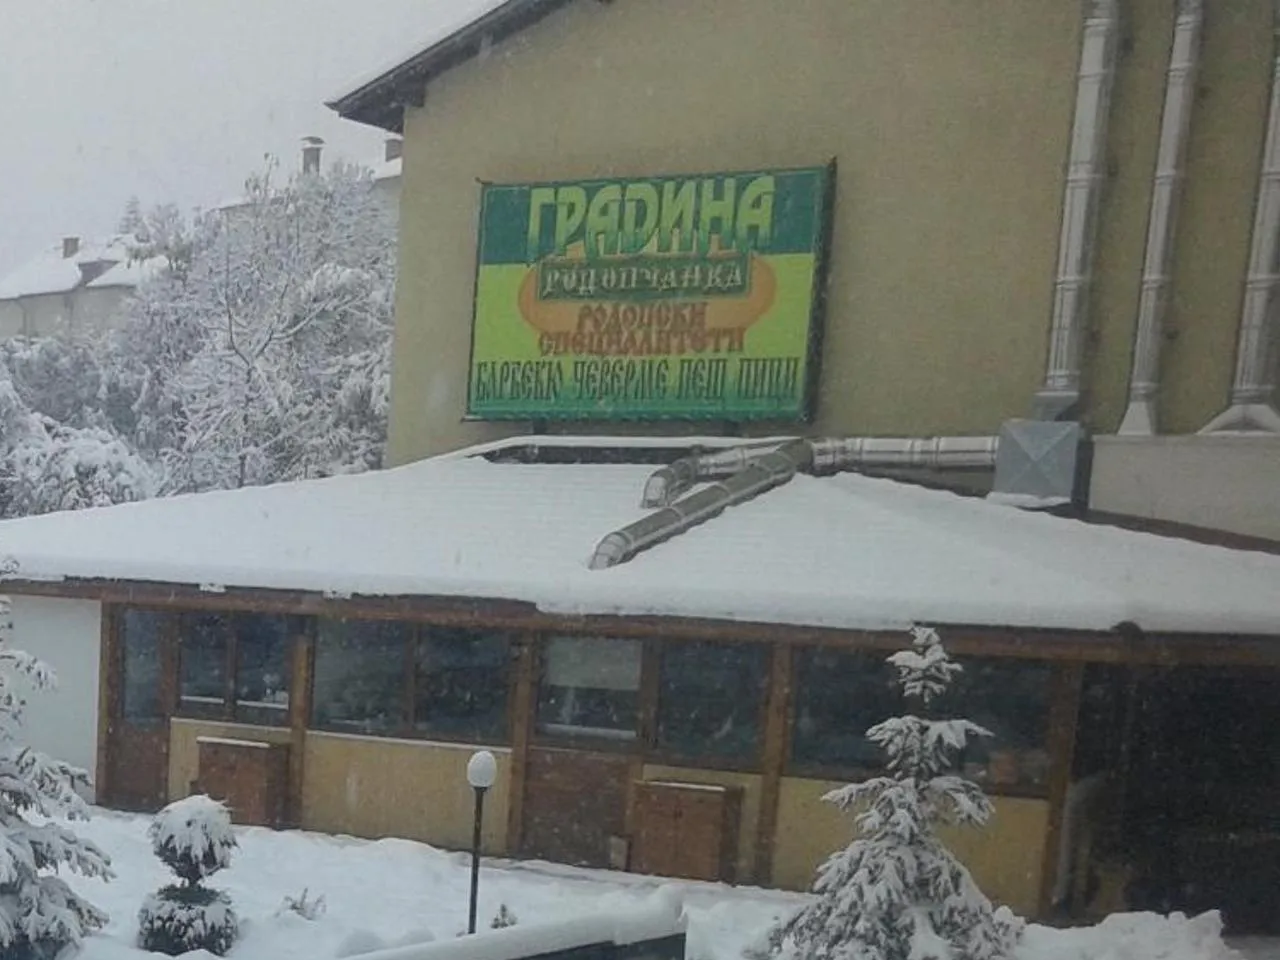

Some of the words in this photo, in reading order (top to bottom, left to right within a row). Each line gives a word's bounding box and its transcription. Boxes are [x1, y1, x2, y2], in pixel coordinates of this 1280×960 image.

[527, 175, 776, 257] ГРАДИНА
[542, 261, 744, 298] РОДОПЧАНКА
[475, 359, 563, 401] БАРБЕКЮ
[573, 357, 670, 401] ЧЕВЕРМЕ
[676, 357, 729, 402] ПЕЩ
